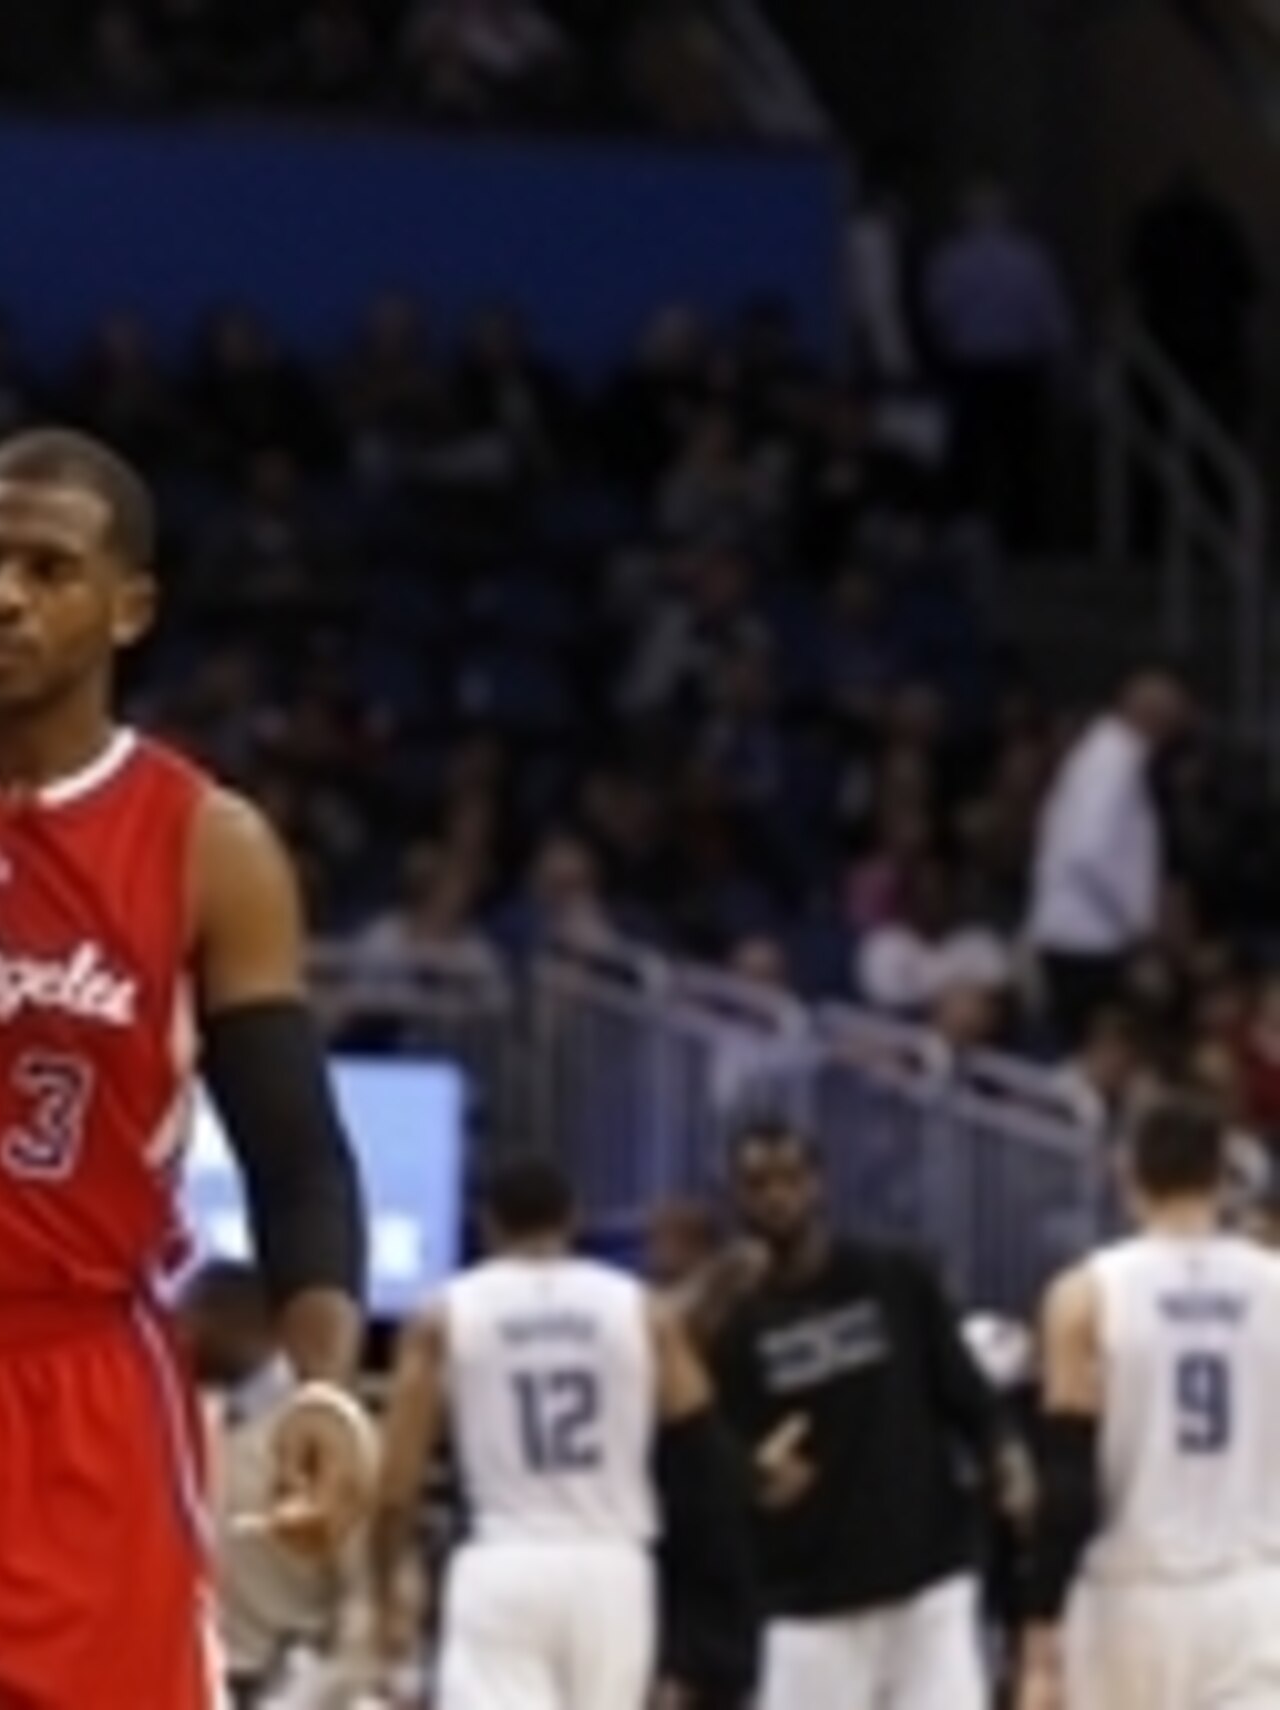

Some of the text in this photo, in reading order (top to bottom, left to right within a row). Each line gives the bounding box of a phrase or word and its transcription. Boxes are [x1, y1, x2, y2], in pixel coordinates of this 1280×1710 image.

[0, 1051, 96, 1181] 3
[512, 1369, 601, 1474] 12
[1176, 1351, 1232, 1454] 9
